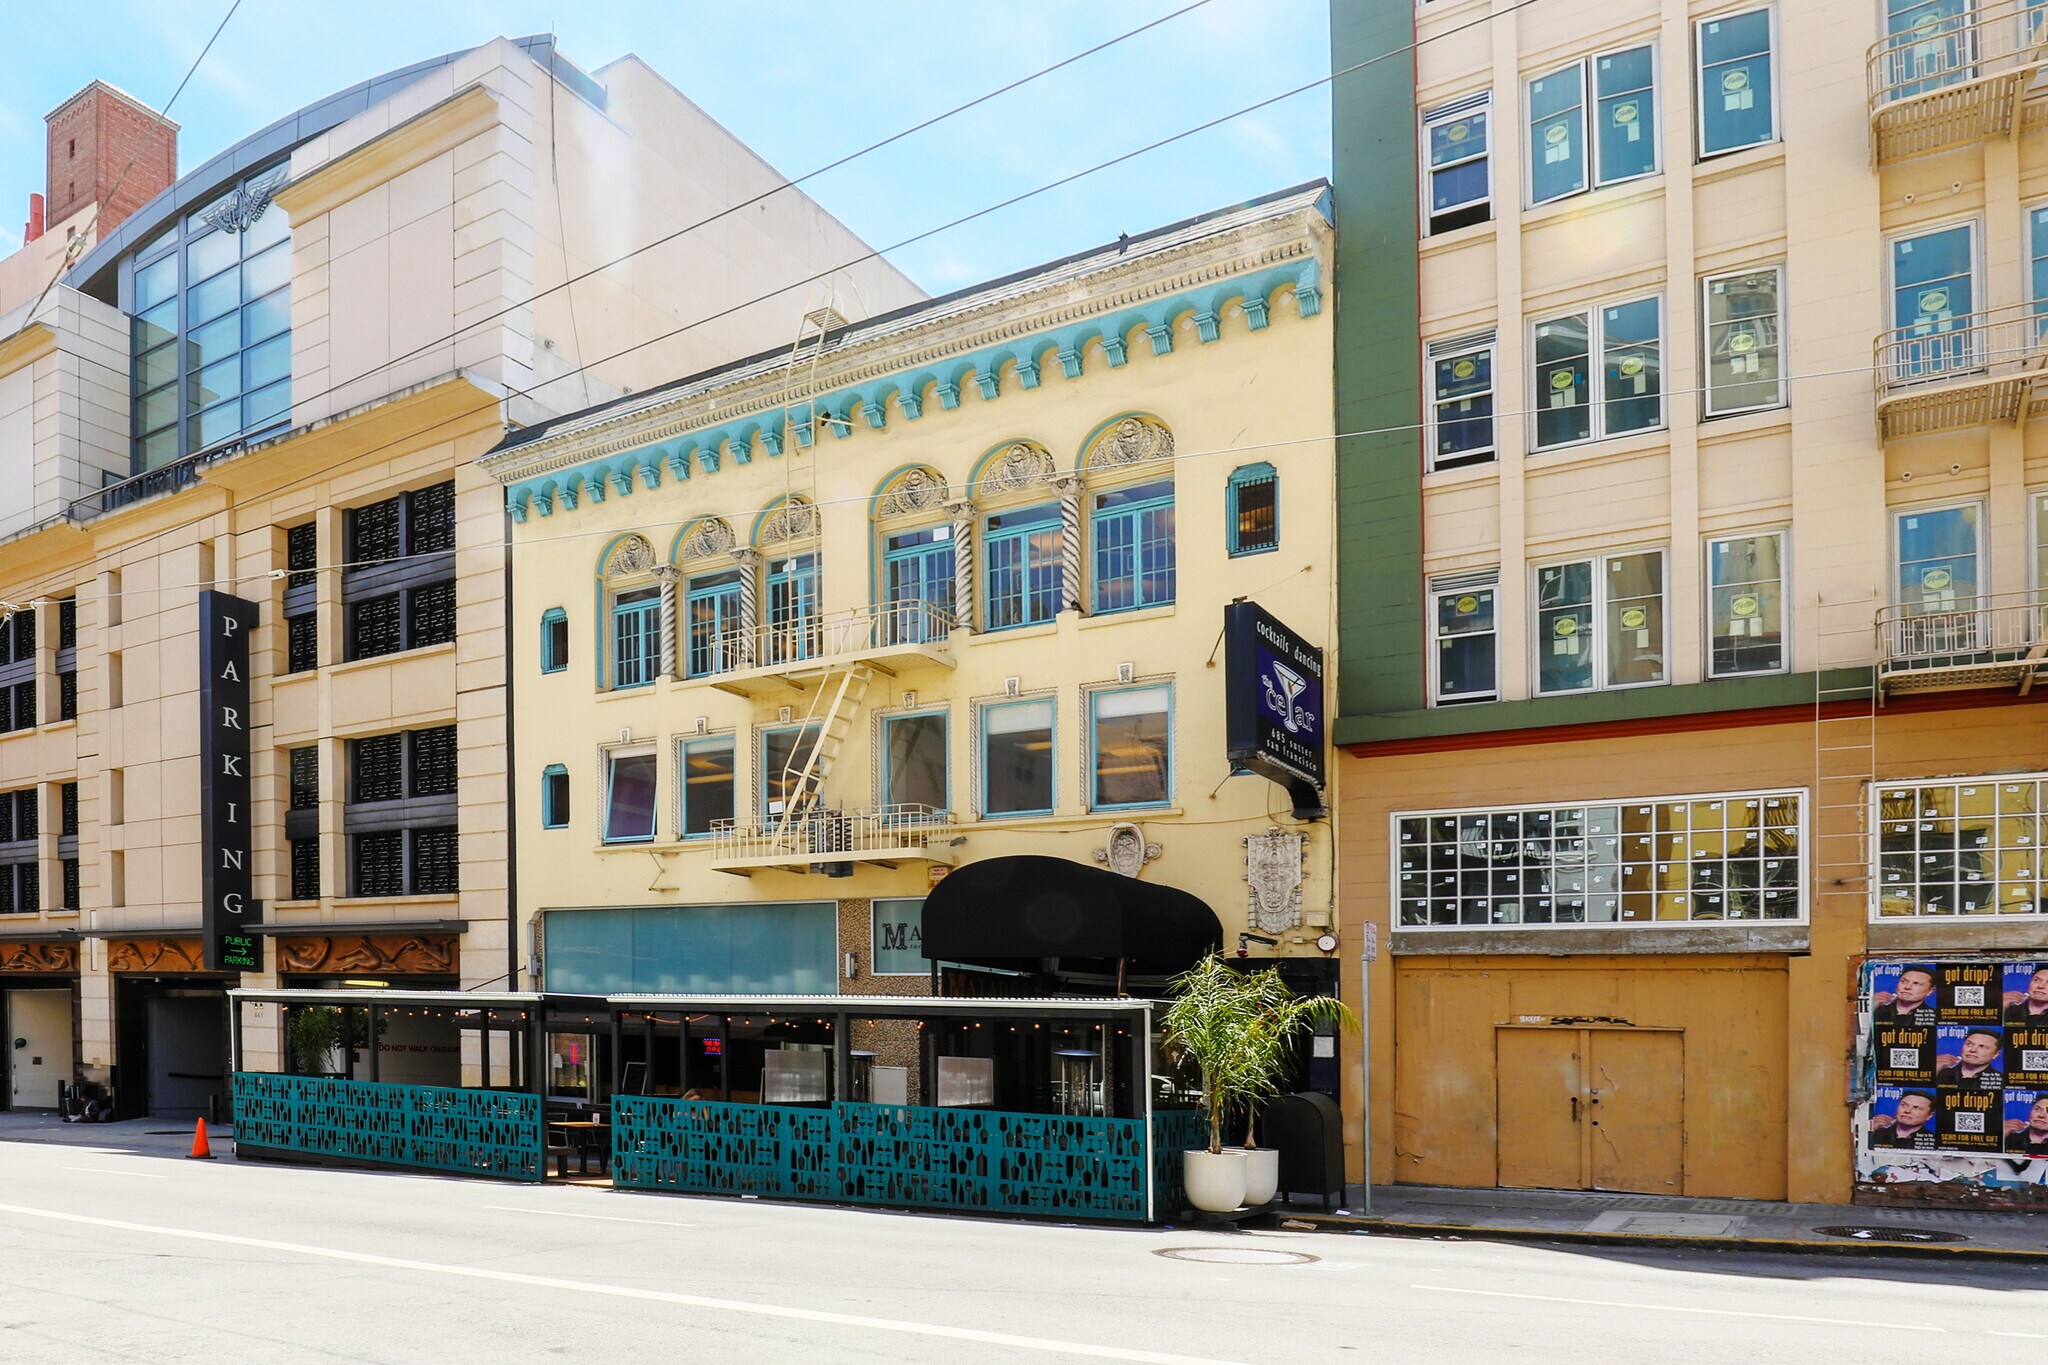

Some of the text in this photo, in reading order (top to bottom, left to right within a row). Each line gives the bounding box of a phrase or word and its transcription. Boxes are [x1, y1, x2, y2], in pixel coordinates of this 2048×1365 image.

[1256, 621, 1322, 678] cocktails dancing
[1271, 728, 1312, 758] 685 sutter
[1266, 738, 1317, 772] san francisco
[221, 616, 243, 914] PARKING
[225, 936, 252, 946] PUBLIC
[224, 955, 254, 966] PARKING
[1874, 964, 1903, 976] got dripp?
[1945, 965, 1994, 984] got dripp?
[2003, 963, 2036, 975] got dripp?
[1941, 1008, 1998, 1016] SCAN FOR FREE GIFT
[1881, 1028, 1928, 1047] got dripp?
[1937, 1026, 1968, 1039] got dripp?
[2012, 1029, 2028, 1048] got
[379, 1044, 390, 1052] DO
[409, 1045, 429, 1053] WALK
[1905, 1070, 1918, 1078] FREE
[1920, 1070, 1932, 1078] GIFT
[2008, 1072, 2025, 1080] SCAN
[1884, 1088, 1903, 1100] dripp?
[2004, 1091, 2037, 1104] got dripp?
[1945, 1091, 1994, 1111] got dripp?
[1941, 1133, 1957, 1141] SCAN
[1985, 1135, 1998, 1143] GIFT
